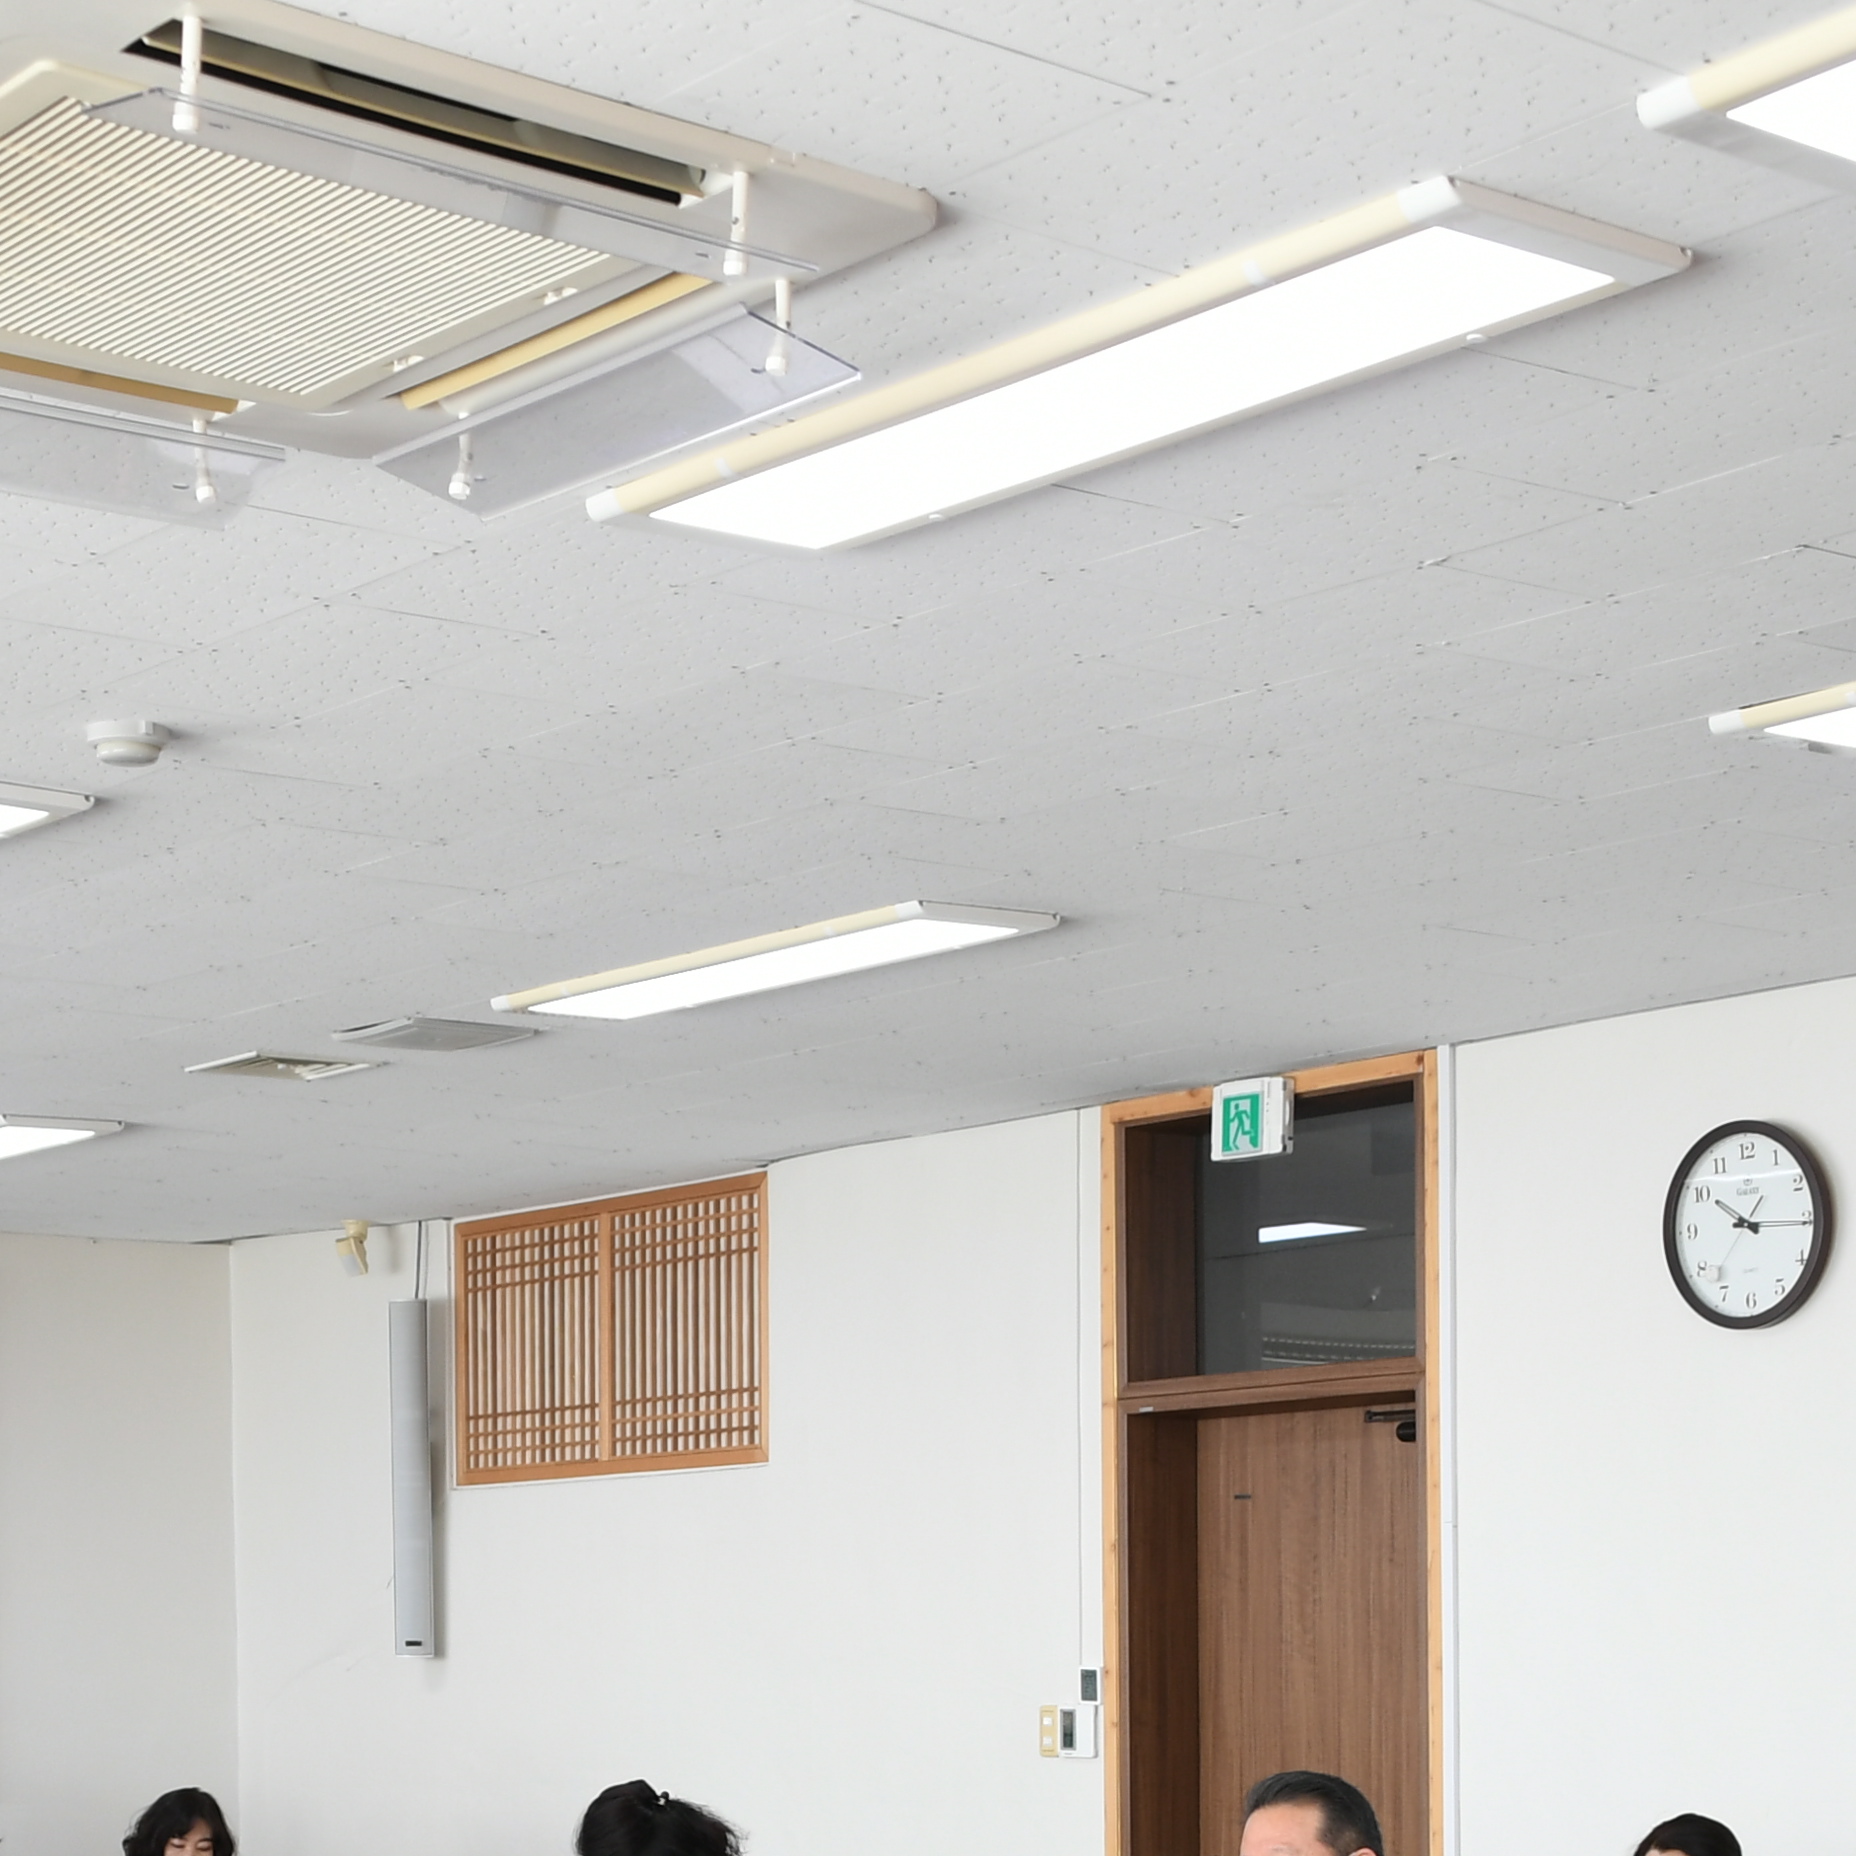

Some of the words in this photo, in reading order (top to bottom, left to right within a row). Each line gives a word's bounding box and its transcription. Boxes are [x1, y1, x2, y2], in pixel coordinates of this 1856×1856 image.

[1739, 1141, 1756, 1160] 12
[1772, 1149, 1780, 1166] 1
[1713, 1157, 1727, 1174] 11
[1793, 1174, 1804, 1192] 2
[1693, 1185, 1711, 1203] 10
[1687, 1223, 1698, 1240] 9
[1795, 1249, 1808, 1266] 4
[1719, 1285, 1729, 1302] 7
[1774, 1278, 1786, 1296] 5
[1746, 1292, 1757, 1309] 6
